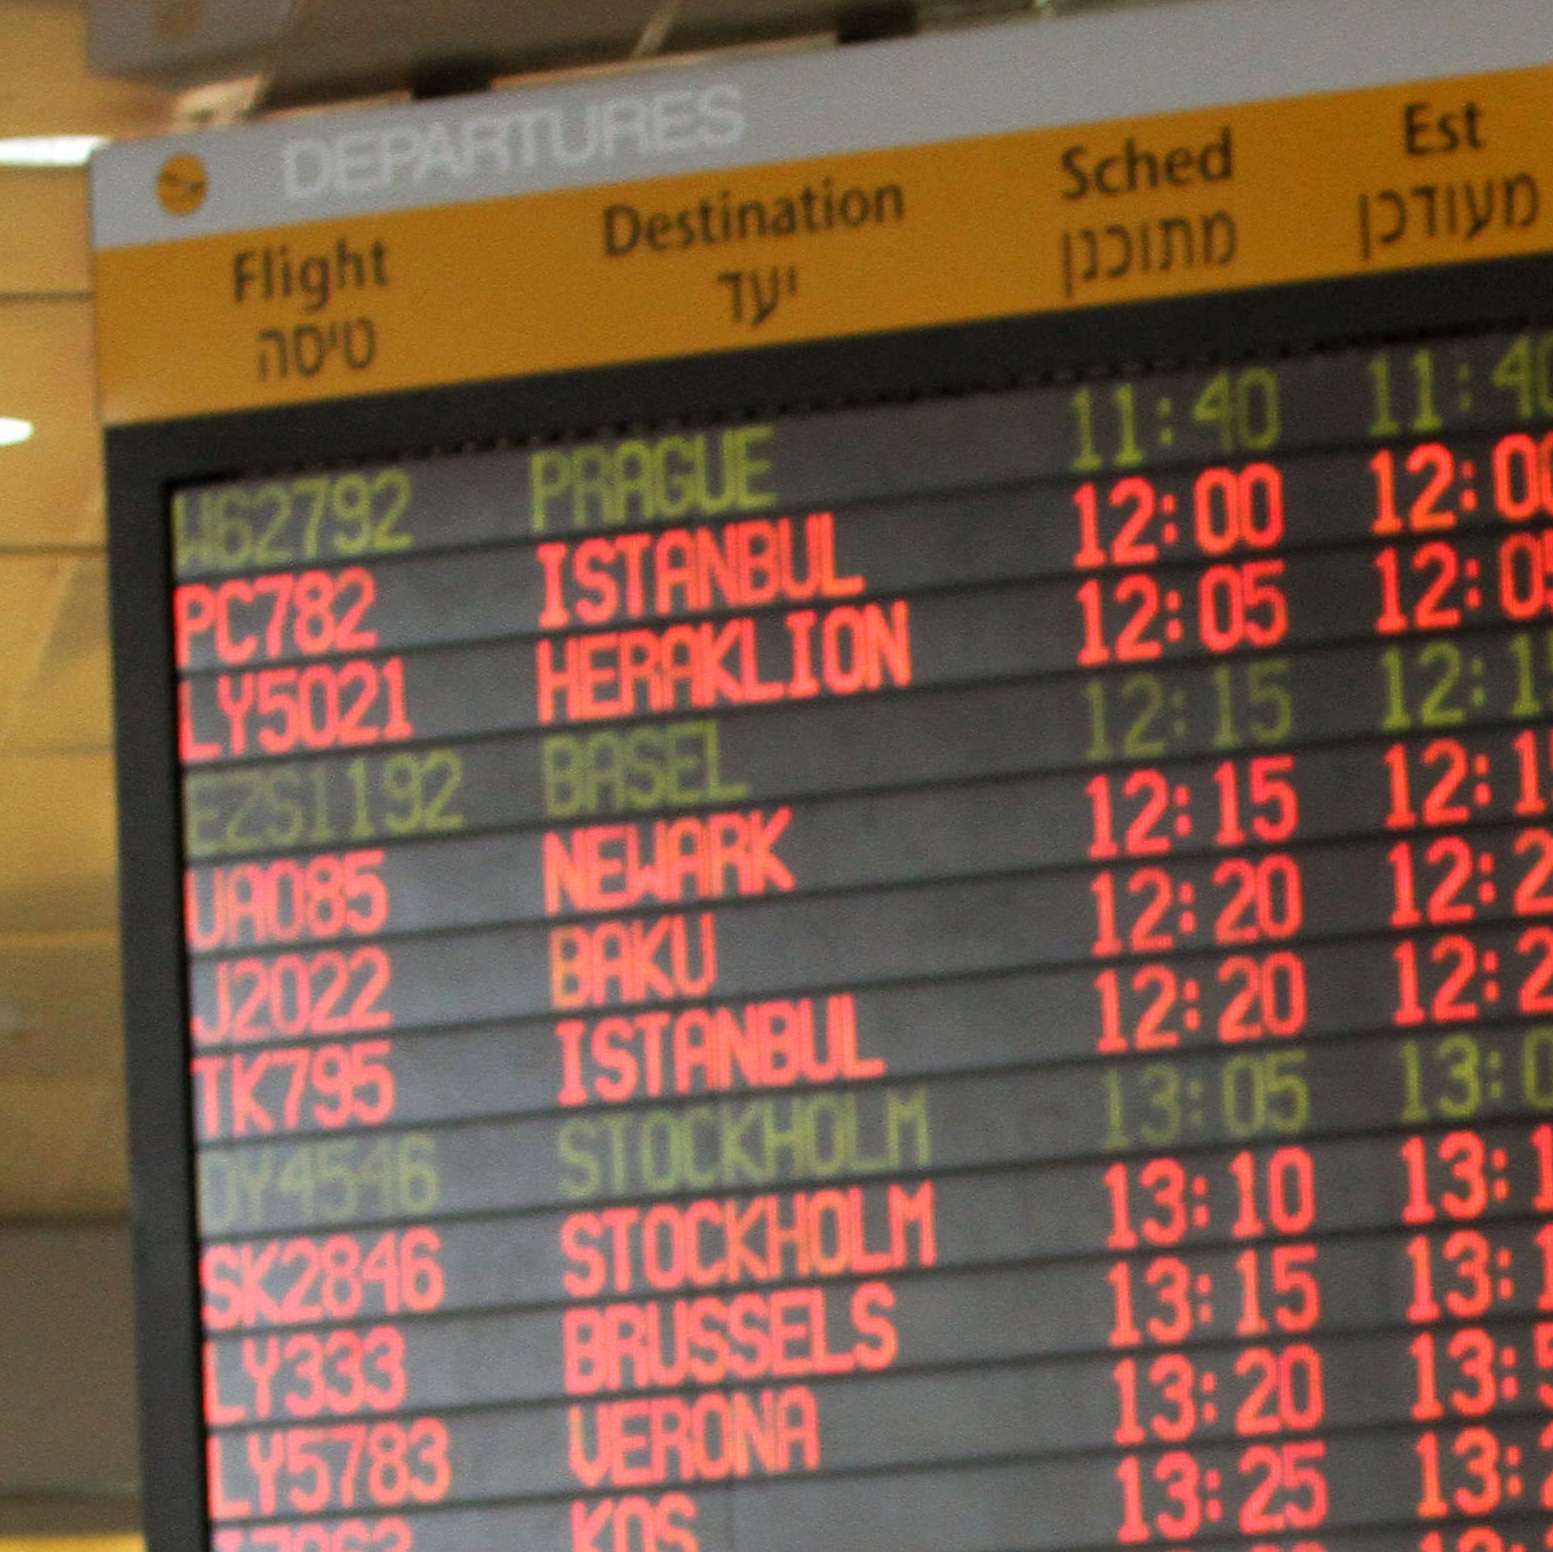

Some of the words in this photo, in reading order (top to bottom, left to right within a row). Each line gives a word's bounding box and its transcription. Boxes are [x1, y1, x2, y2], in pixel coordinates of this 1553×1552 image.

[281, 83, 748, 199] DEPARTURES
[1060, 126, 1234, 201] Sched
[1402, 101, 1485, 157] Est
[602, 177, 905, 258] Destination
[1061, 209, 1238, 297] מתוכנן
[1357, 171, 1540, 261] מעודכן
[232, 238, 389, 313] Flight
[717, 266, 797, 327] יעד
[258, 317, 376, 378] טיסה
[530, 425, 777, 532] PRAGUE
[1071, 366, 1282, 471] 11:40
[173, 566, 379, 666] PC782
[537, 512, 867, 629] ISTANBUL
[1073, 461, 1287, 569] 12:00
[178, 657, 414, 762] LY5021
[537, 599, 913, 723] HERAKLION
[1077, 558, 1290, 667] 12:05
[541, 719, 749, 820] BASEL
[185, 849, 389, 945] UA085
[544, 806, 796, 913] NEWARK
[1086, 755, 1300, 859] 12:15
[552, 912, 717, 1007] BAKU
[1091, 853, 1304, 957] 12:20
[191, 1040, 394, 1133] TK795
[557, 994, 886, 1105] ISTANBUL
[1095, 950, 1308, 1054] 12:20
[557, 1088, 932, 1199] STOCKHOLM
[199, 1228, 445, 1329] SK2846
[562, 1181, 937, 1297] STOCKHOLM
[1105, 1146, 1317, 1250] 13:10
[203, 1325, 407, 1425] LY333
[564, 1281, 898, 1395] BRUSSELS
[1108, 1243, 1322, 1347] 13:15
[206, 1418, 451, 1518] LY5783
[570, 1386, 821, 1487] VERONA
[1114, 1343, 1326, 1445] 13:20
[1117, 1440, 1330, 1544] 13:25
